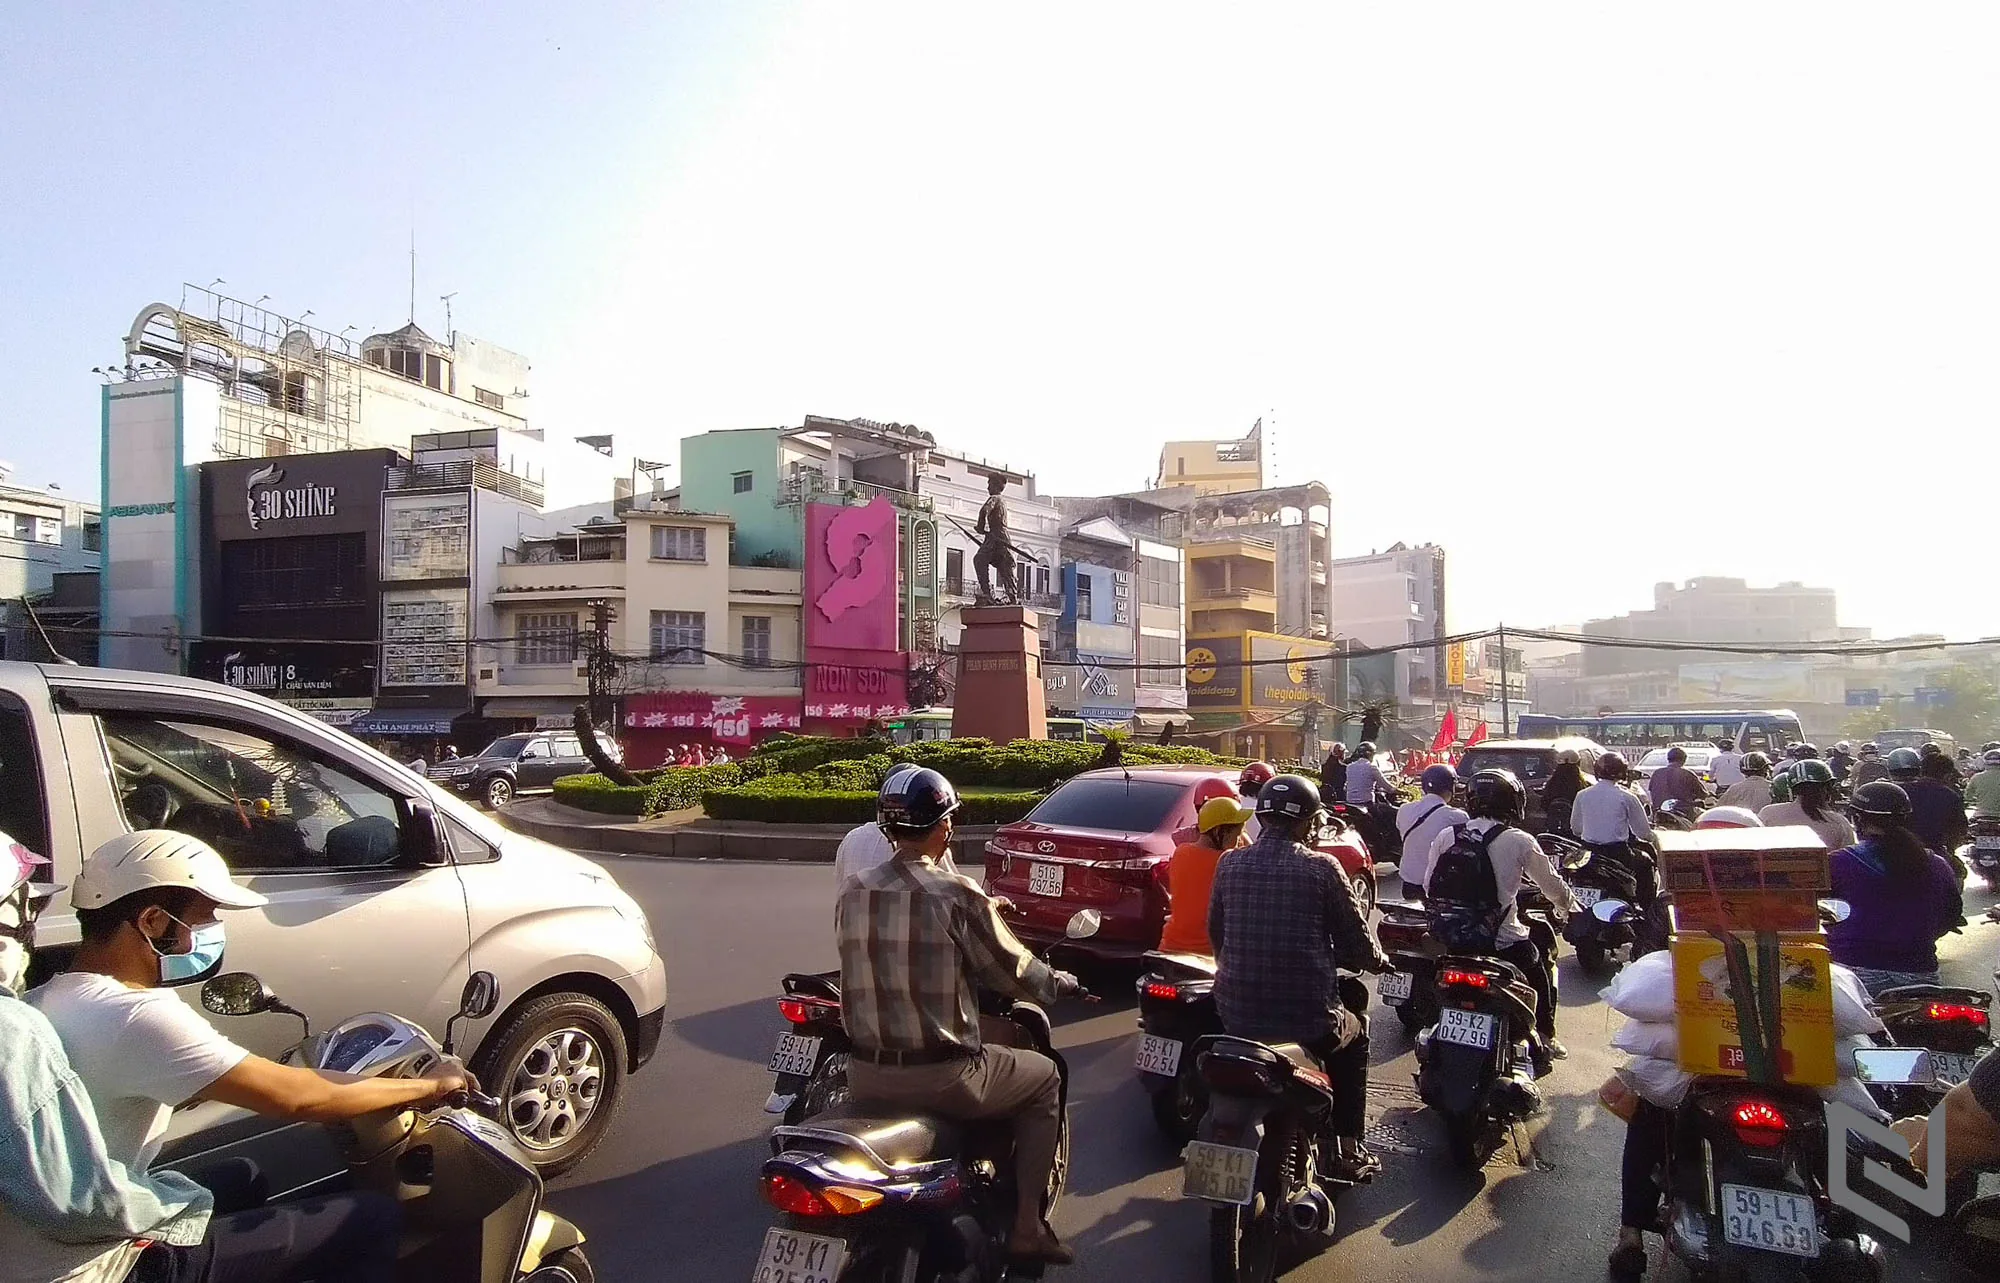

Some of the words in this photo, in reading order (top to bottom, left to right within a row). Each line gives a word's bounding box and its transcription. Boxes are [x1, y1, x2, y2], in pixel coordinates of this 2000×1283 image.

[260, 489, 282, 520] 30
[285, 484, 335, 518] SHINE
[232, 665, 244, 685] 30
[247, 663, 276, 686] SHINE
[286, 665, 296, 680] 8
[391, 723, 410, 731] ANH
[1038, 865, 1056, 880] 51G
[1030, 878, 1061, 895] 797.56
[1448, 1010, 1485, 1030] 59-K2
[780, 1035, 813, 1056] 59-L1
[1441, 1025, 1487, 1046] 047.96
[1143, 1037, 1174, 1057] 59-K1
[770, 1052, 812, 1075] 578.32
[1136, 1051, 1174, 1073] 902.54
[1195, 1146, 1244, 1174] 59-K1
[1735, 1189, 1798, 1223] 59-L1
[772, 1235, 829, 1272] 59-K1
